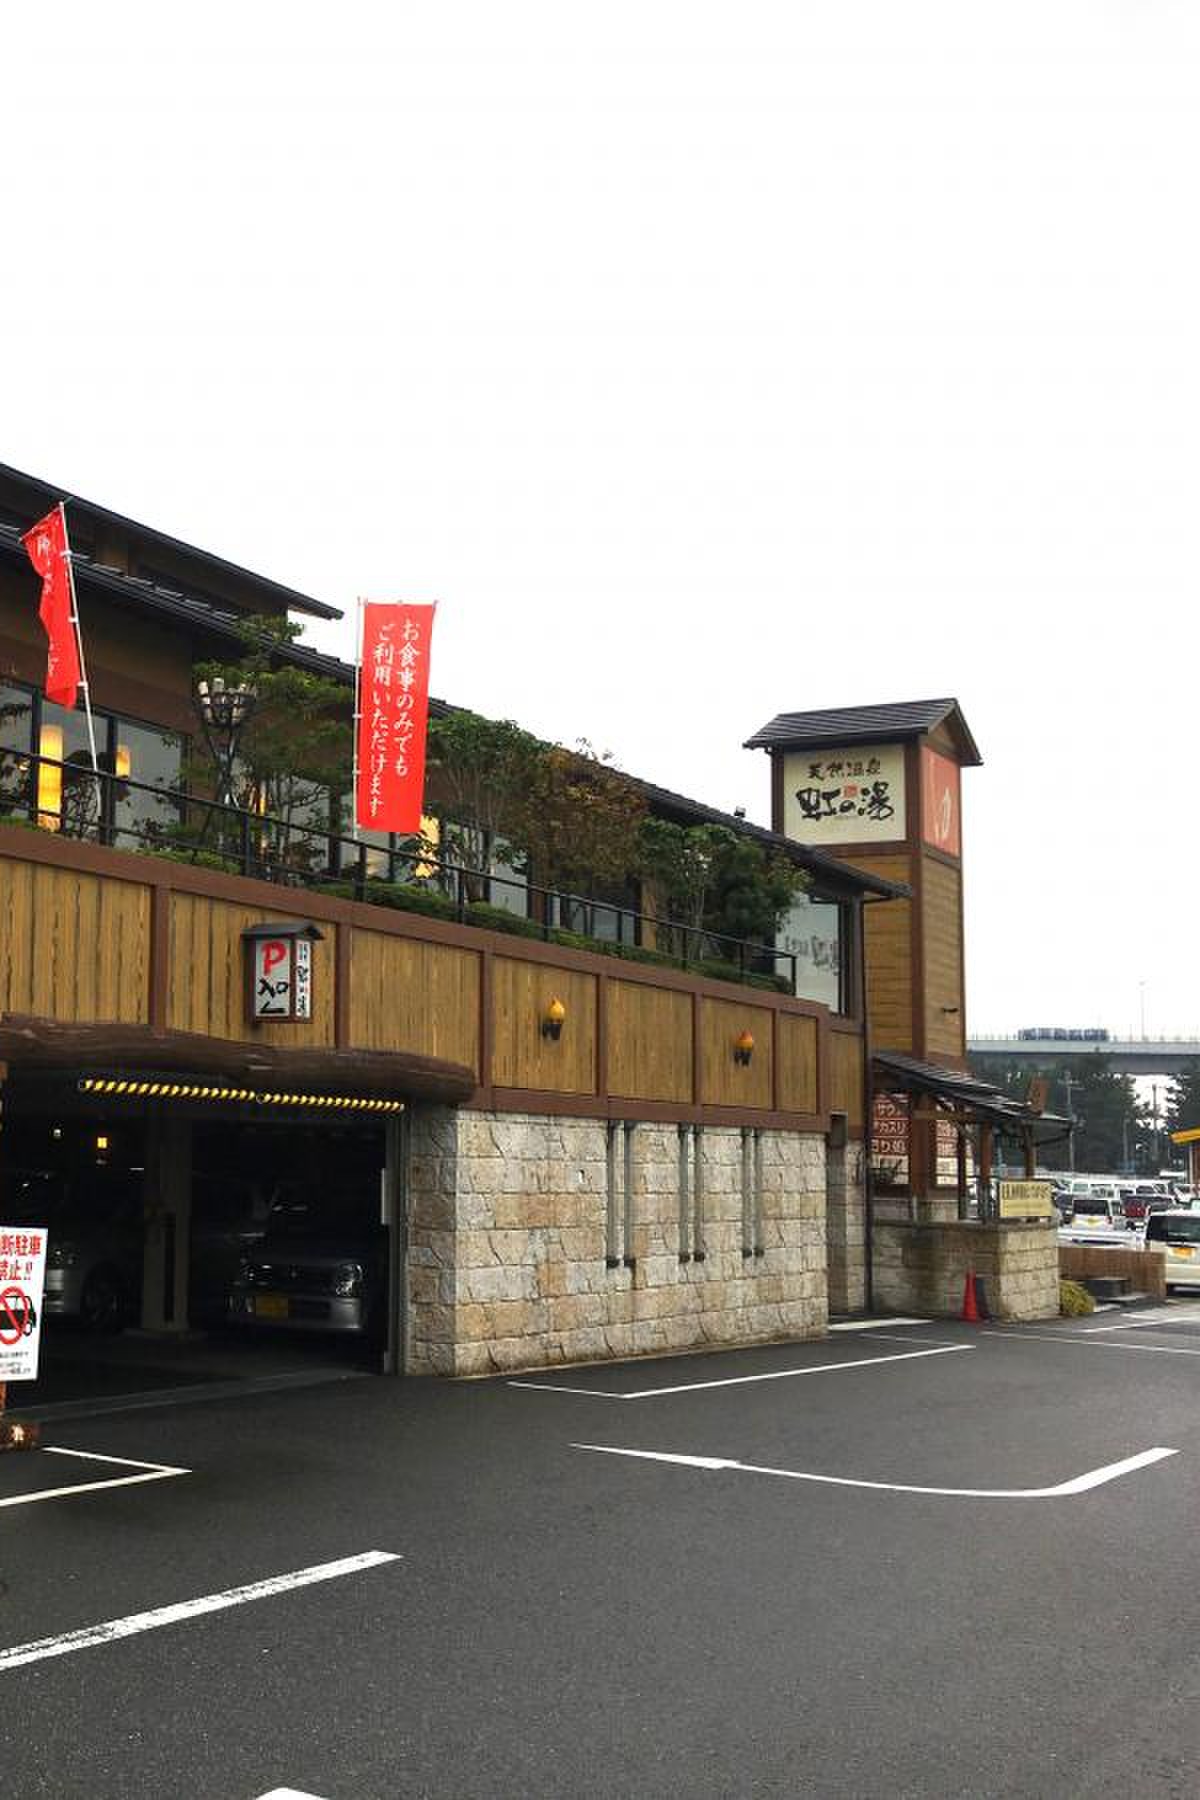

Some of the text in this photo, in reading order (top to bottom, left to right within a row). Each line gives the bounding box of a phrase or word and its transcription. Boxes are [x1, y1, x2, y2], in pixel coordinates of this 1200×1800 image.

[392, 618, 420, 777] お食事のみでも
[370, 622, 395, 818] ご利用いただけます
[807, 756, 880, 781] 天然温泉
[796, 780, 894, 822] 虹の湯
[261, 941, 287, 977] P
